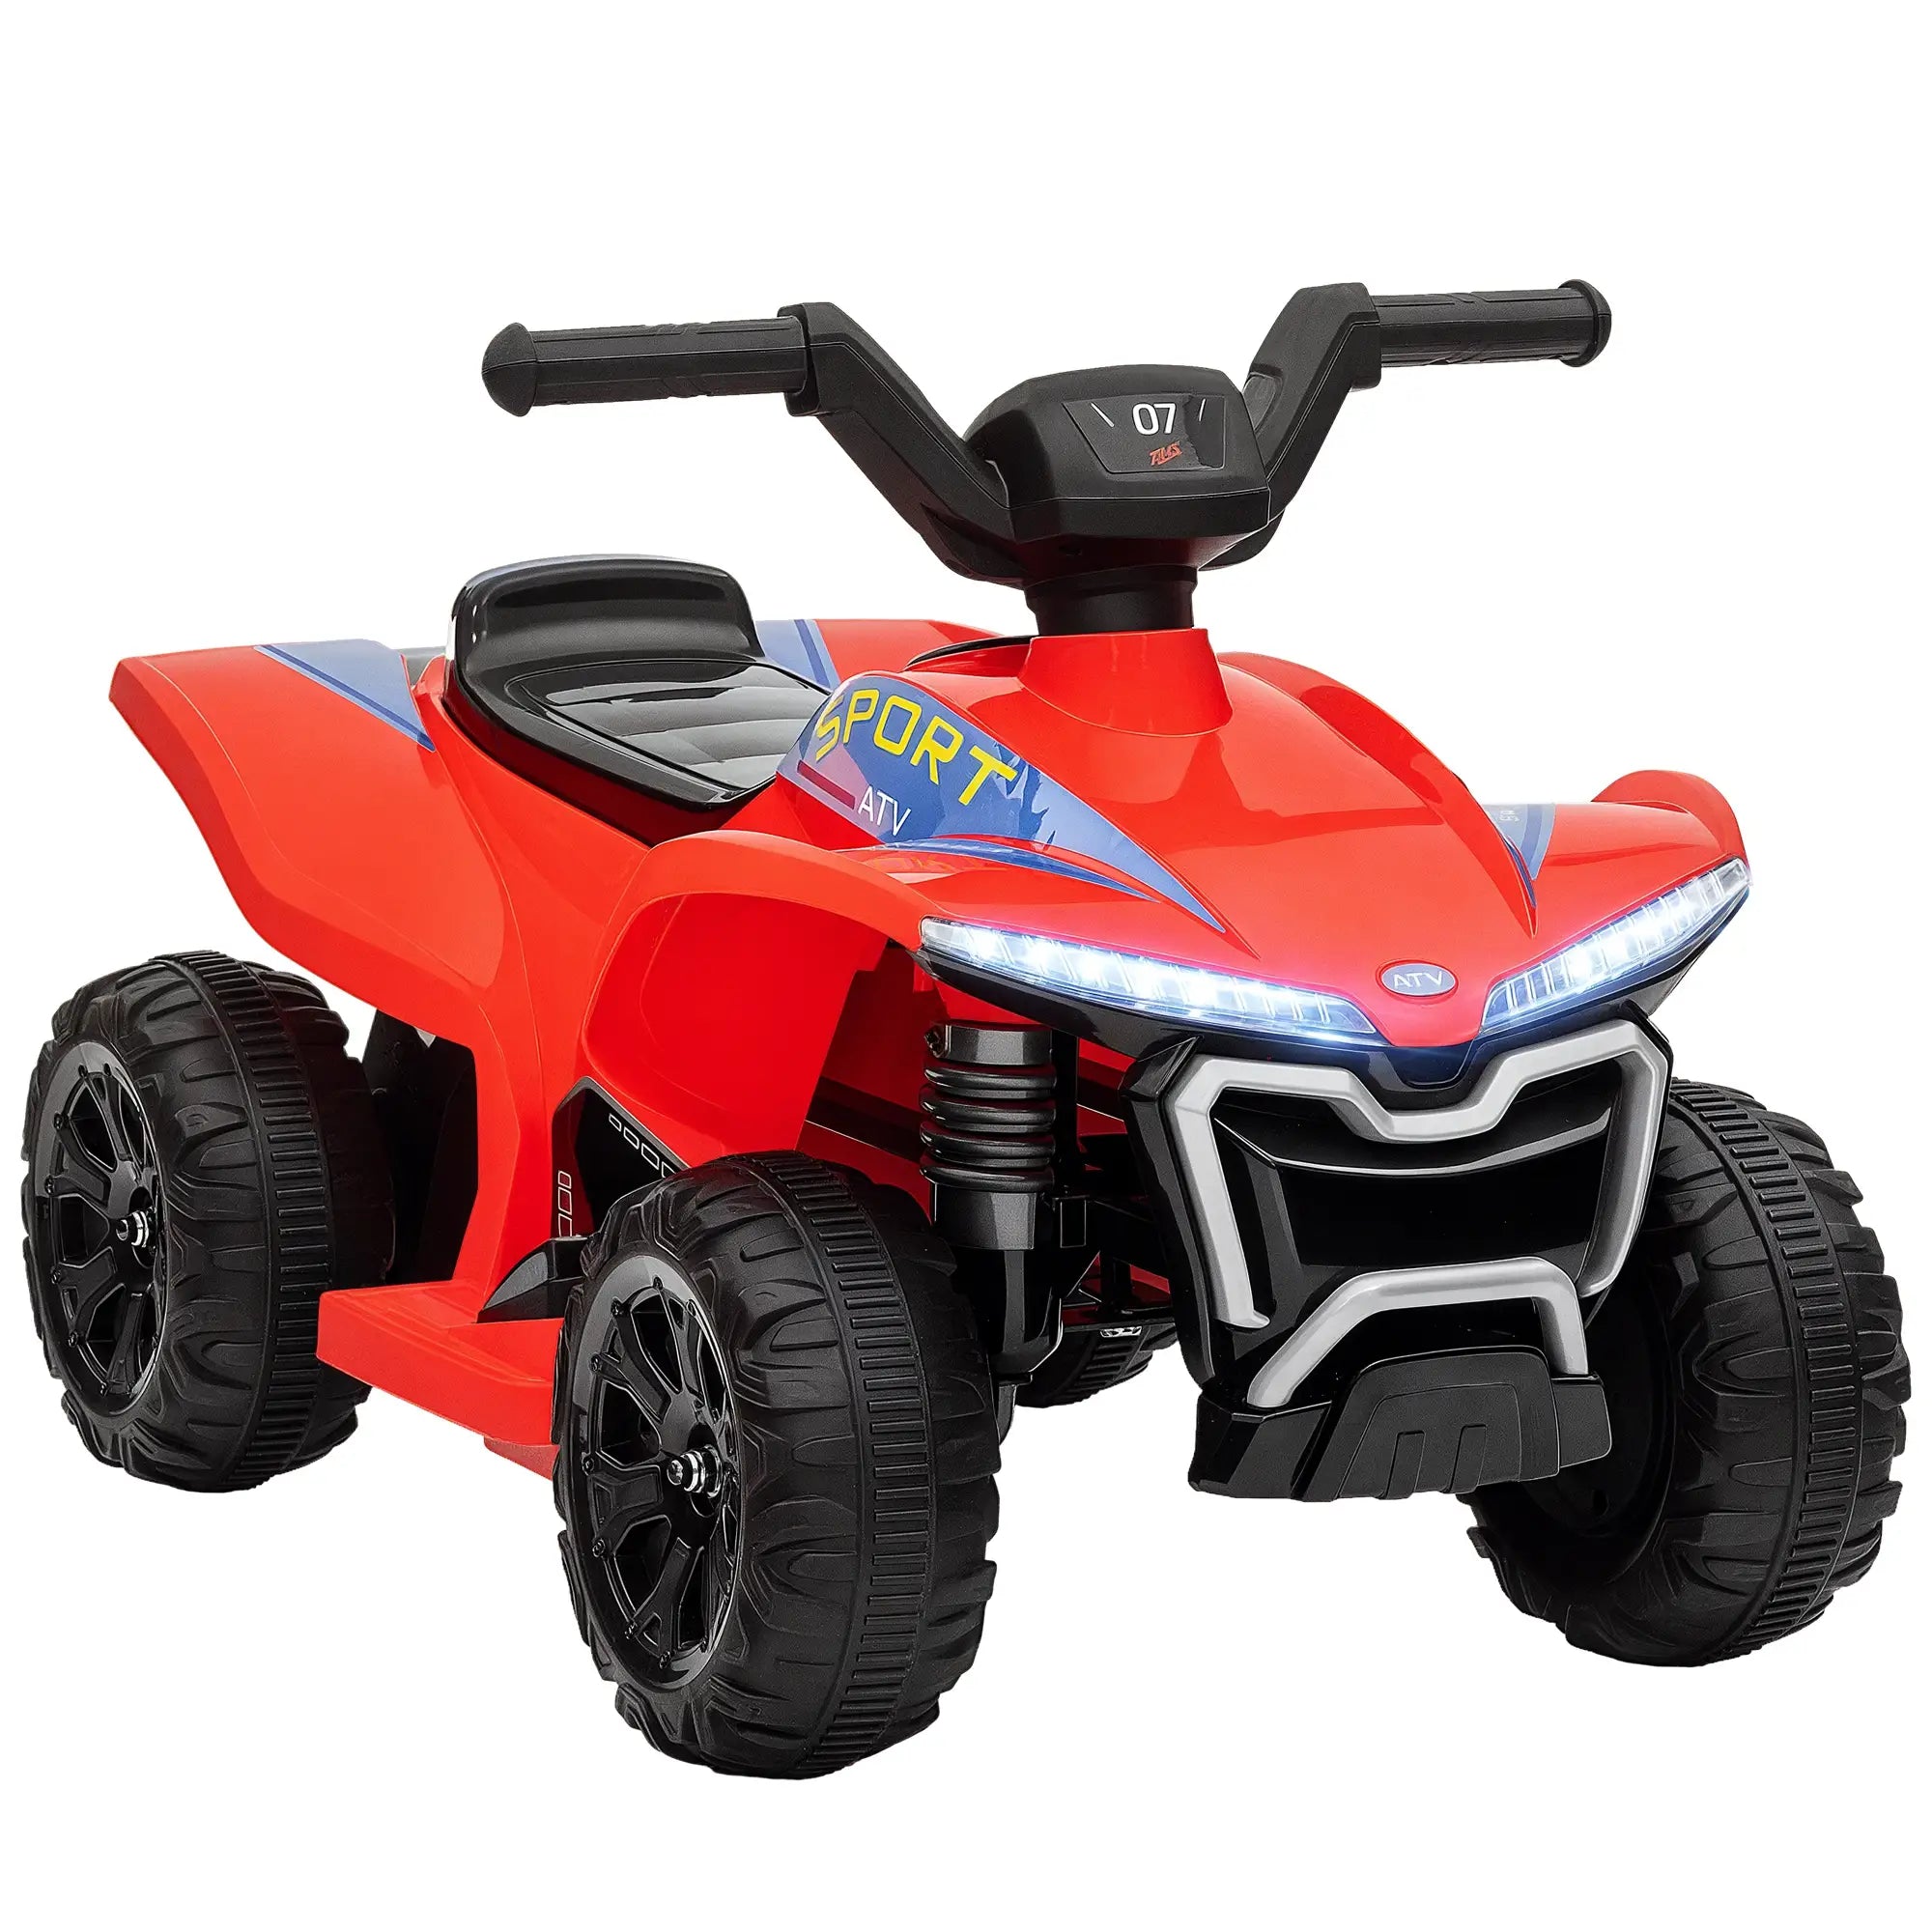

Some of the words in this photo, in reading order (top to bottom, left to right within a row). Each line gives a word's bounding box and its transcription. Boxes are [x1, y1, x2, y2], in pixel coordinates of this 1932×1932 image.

[1132, 403, 1177, 436] 07
[815, 689, 1017, 807] SPORT
[858, 785, 912, 837] ATV
[1393, 971, 1443, 988] ATV
